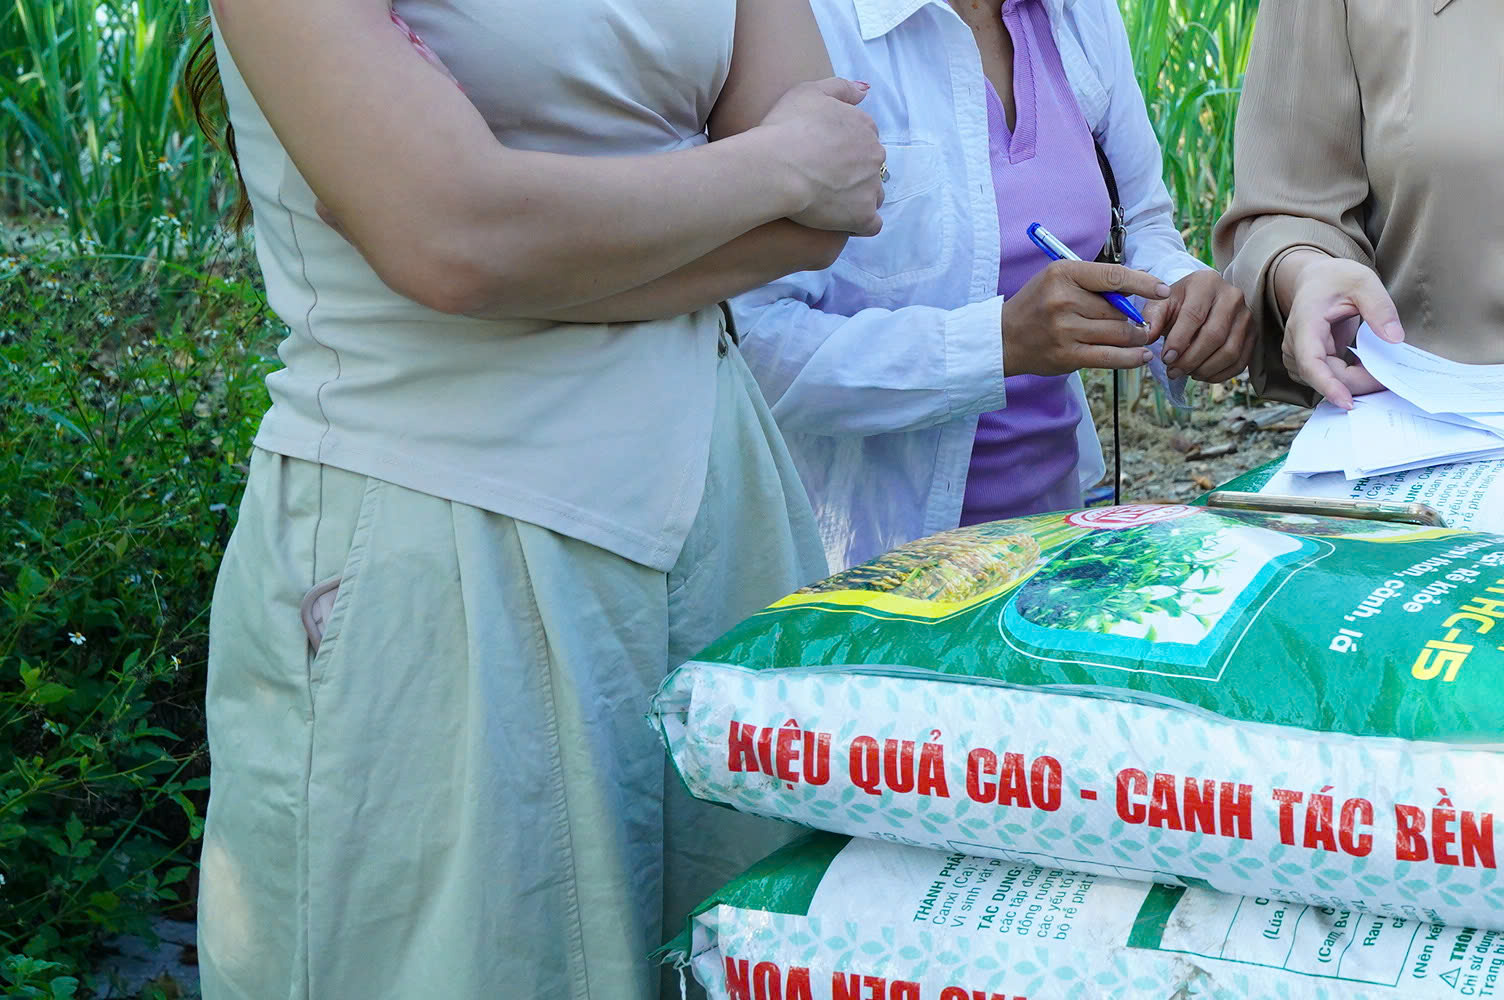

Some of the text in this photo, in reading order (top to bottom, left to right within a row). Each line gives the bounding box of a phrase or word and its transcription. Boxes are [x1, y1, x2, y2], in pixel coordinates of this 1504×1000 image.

[1445, 566, 1481, 584] Rễ
[1343, 579, 1405, 622] cành,
[1402, 580, 1458, 613] khỏe
[1329, 628, 1364, 654] lá
[727, 719, 831, 792] HIỆU
[848, 728, 950, 798] QUẢ
[965, 747, 1064, 813] CAO
[1080, 788, 1097, 801] -
[1116, 766, 1253, 841] CANH
[1272, 784, 1374, 861] TÁC
[1394, 787, 1497, 870] BỀN
[912, 879, 947, 923] THÀNH
[932, 889, 960, 925] Canxi
[952, 862, 980, 890] (Ca):
[949, 914, 968, 928] Vi
[961, 887, 983, 912] sinh
[976, 868, 994, 886] vật
[976, 904, 1001, 931] TÁC
[991, 865, 1026, 902] DỤNG:
[998, 888, 1030, 934] các tập
[1036, 877, 1075, 939] các yếu tố
[1052, 879, 1095, 940] bộ rễ phát
[1016, 903, 1043, 937] đồng
[1261, 905, 1290, 941] (Lúa,
[1363, 921, 1383, 947] Rau
[1317, 929, 1346, 964] (Cam,
[1411, 944, 1435, 980] (Nên
[1449, 926, 1479, 963] THÔN
[1459, 929, 1499, 997] Chỉ sử dụng
[1479, 962, 1502, 999] Trang
